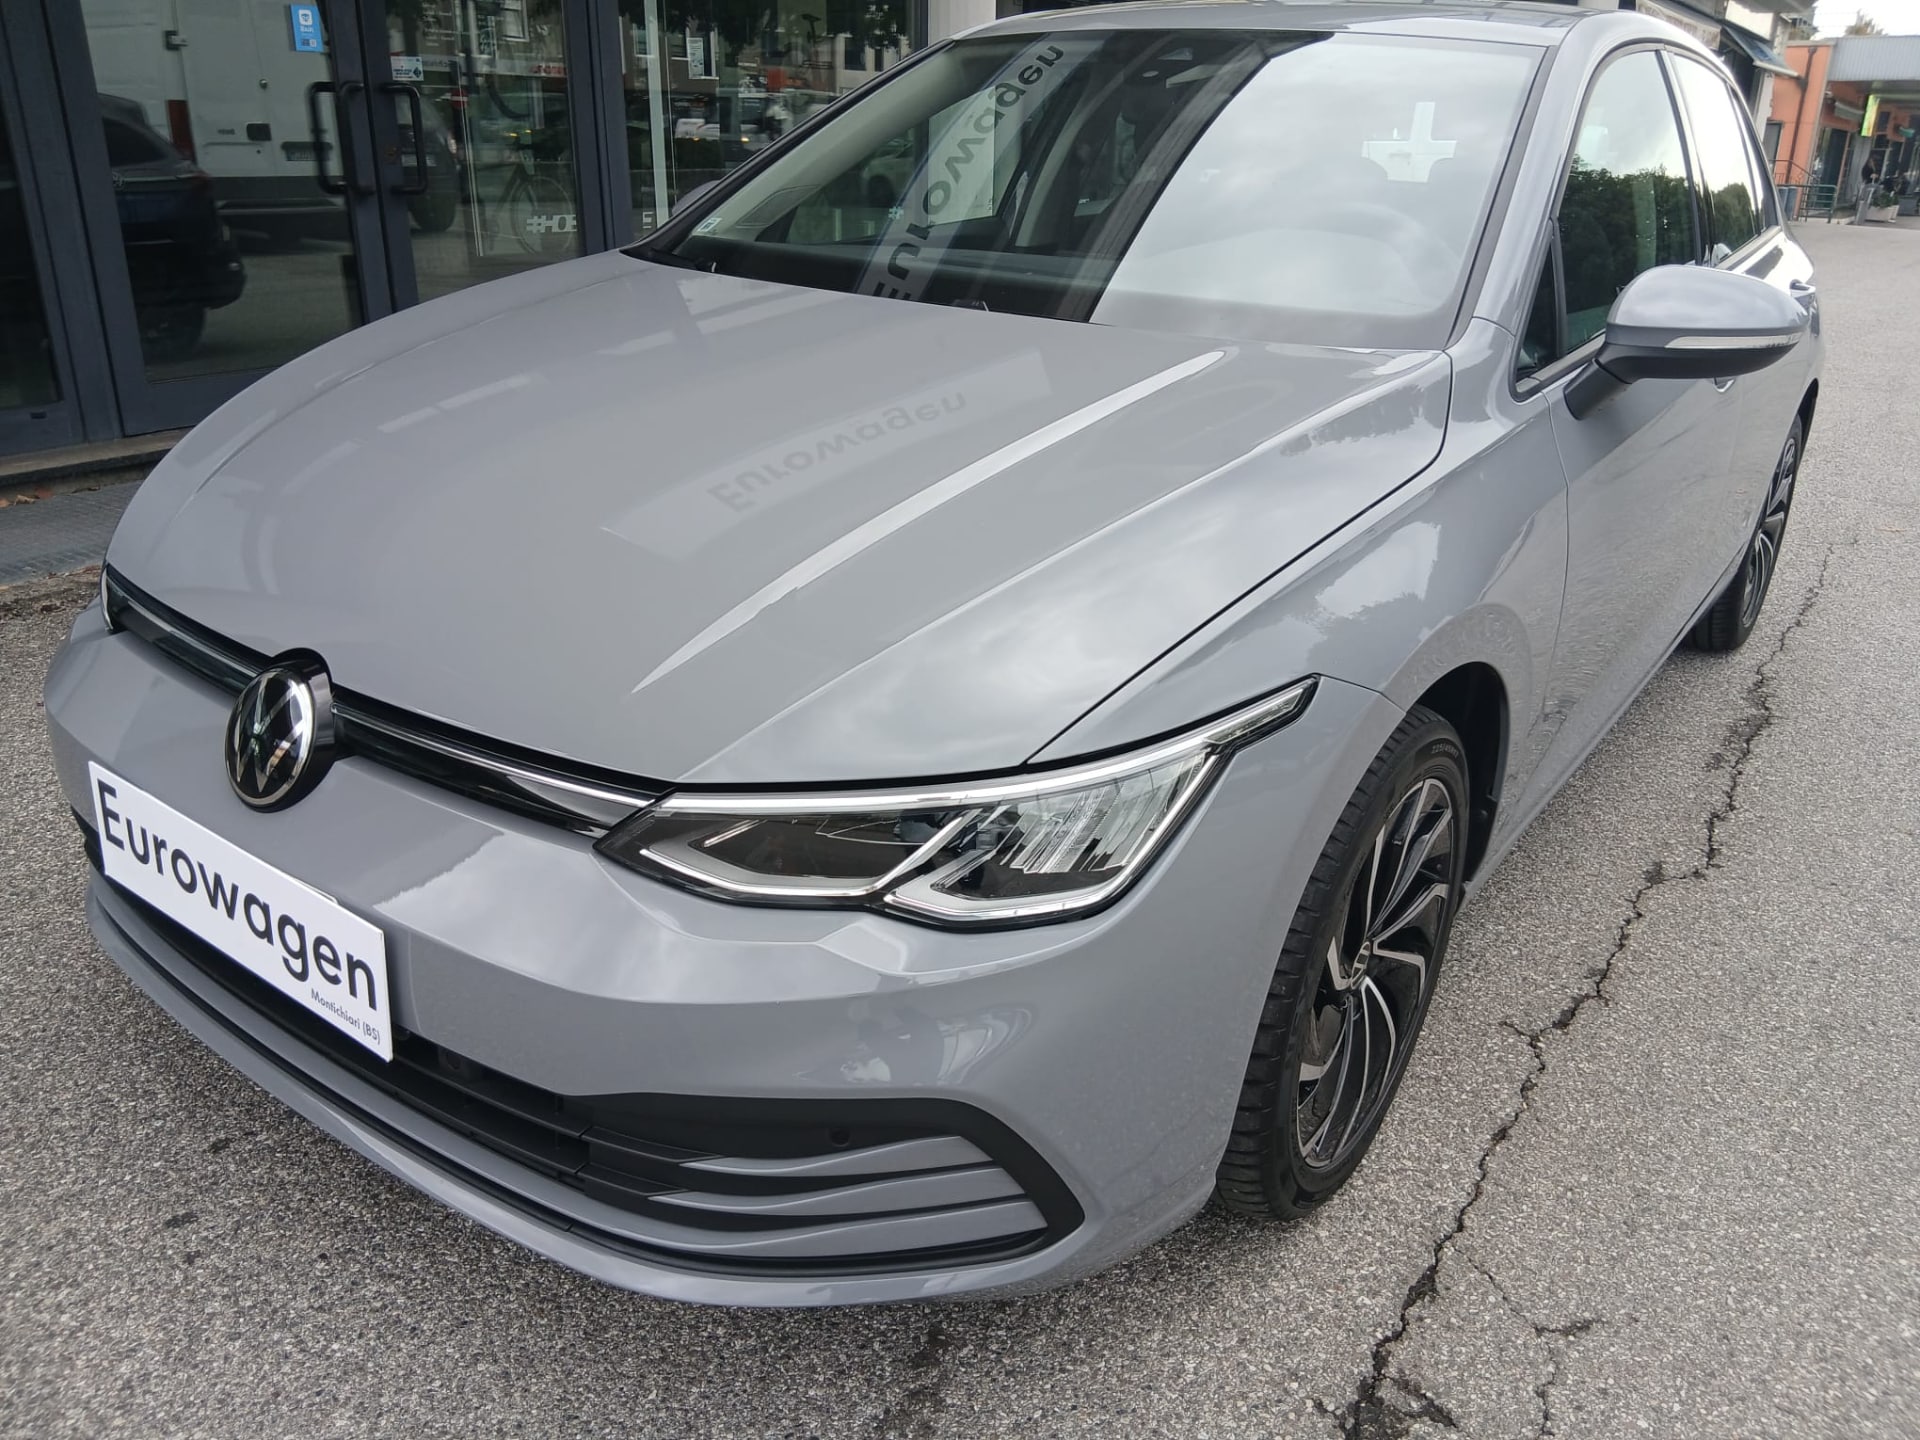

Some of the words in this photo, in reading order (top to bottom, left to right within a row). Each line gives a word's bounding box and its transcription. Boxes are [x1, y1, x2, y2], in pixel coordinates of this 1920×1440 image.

[97, 779, 377, 1011] Eurowagen
[311, 988, 360, 1029] Montichiari
[363, 1021, 381, 1045] (BS)
